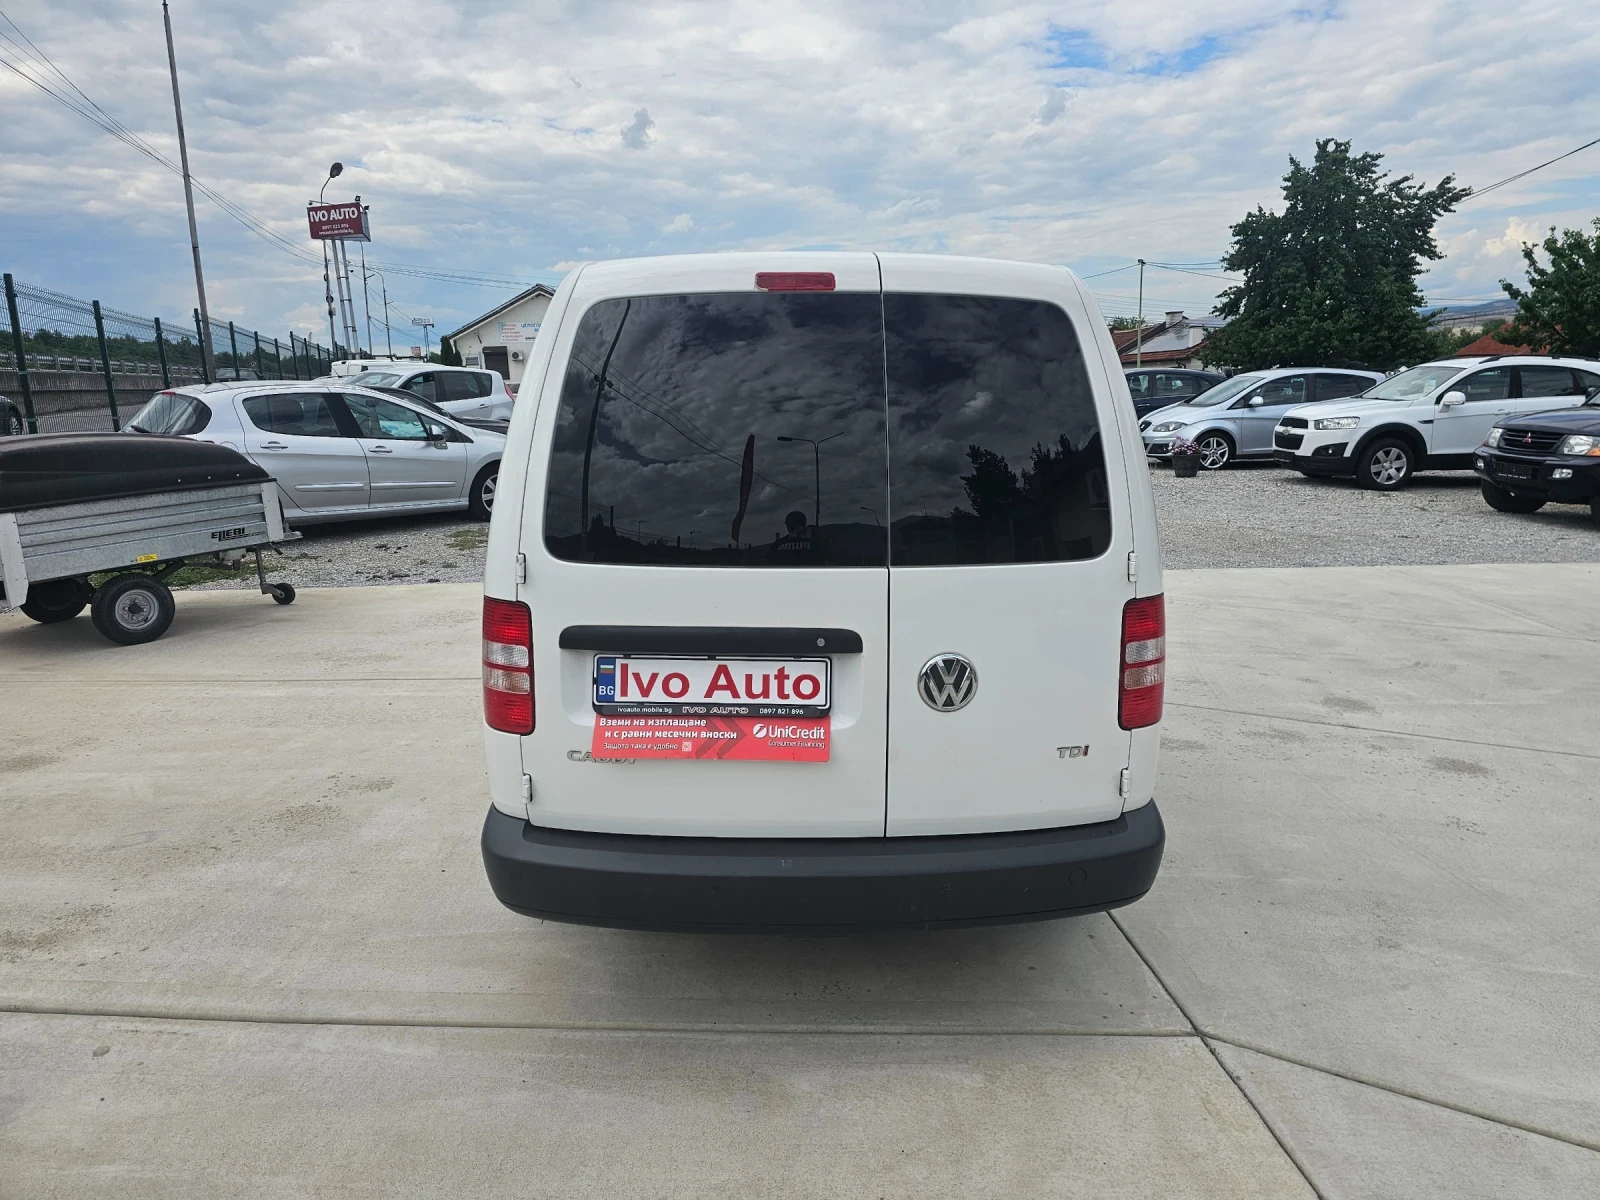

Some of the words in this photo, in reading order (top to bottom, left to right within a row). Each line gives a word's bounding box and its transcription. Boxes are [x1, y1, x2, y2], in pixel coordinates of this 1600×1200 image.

[310, 210, 328, 222] IVO
[330, 207, 358, 220] AUTO
[620, 663, 690, 699] Ivo
[703, 664, 821, 700] Auto
[598, 686, 615, 695] BG
[617, 706, 673, 714] ivoauto.mobile.bg
[682, 706, 707, 714] IVO
[709, 706, 749, 714] AUTO
[599, 717, 631, 726] Вземи
[633, 718, 645, 726] на
[648, 719, 707, 728] изплащане
[621, 731, 652, 739] равни
[700, 731, 737, 739] вноски
[768, 725, 825, 739] UniCredit
[603, 742, 629, 750] Защото
[653, 742, 679, 750] удобно
[797, 740, 825, 750] Financing
[1057, 744, 1090, 758] TDI
